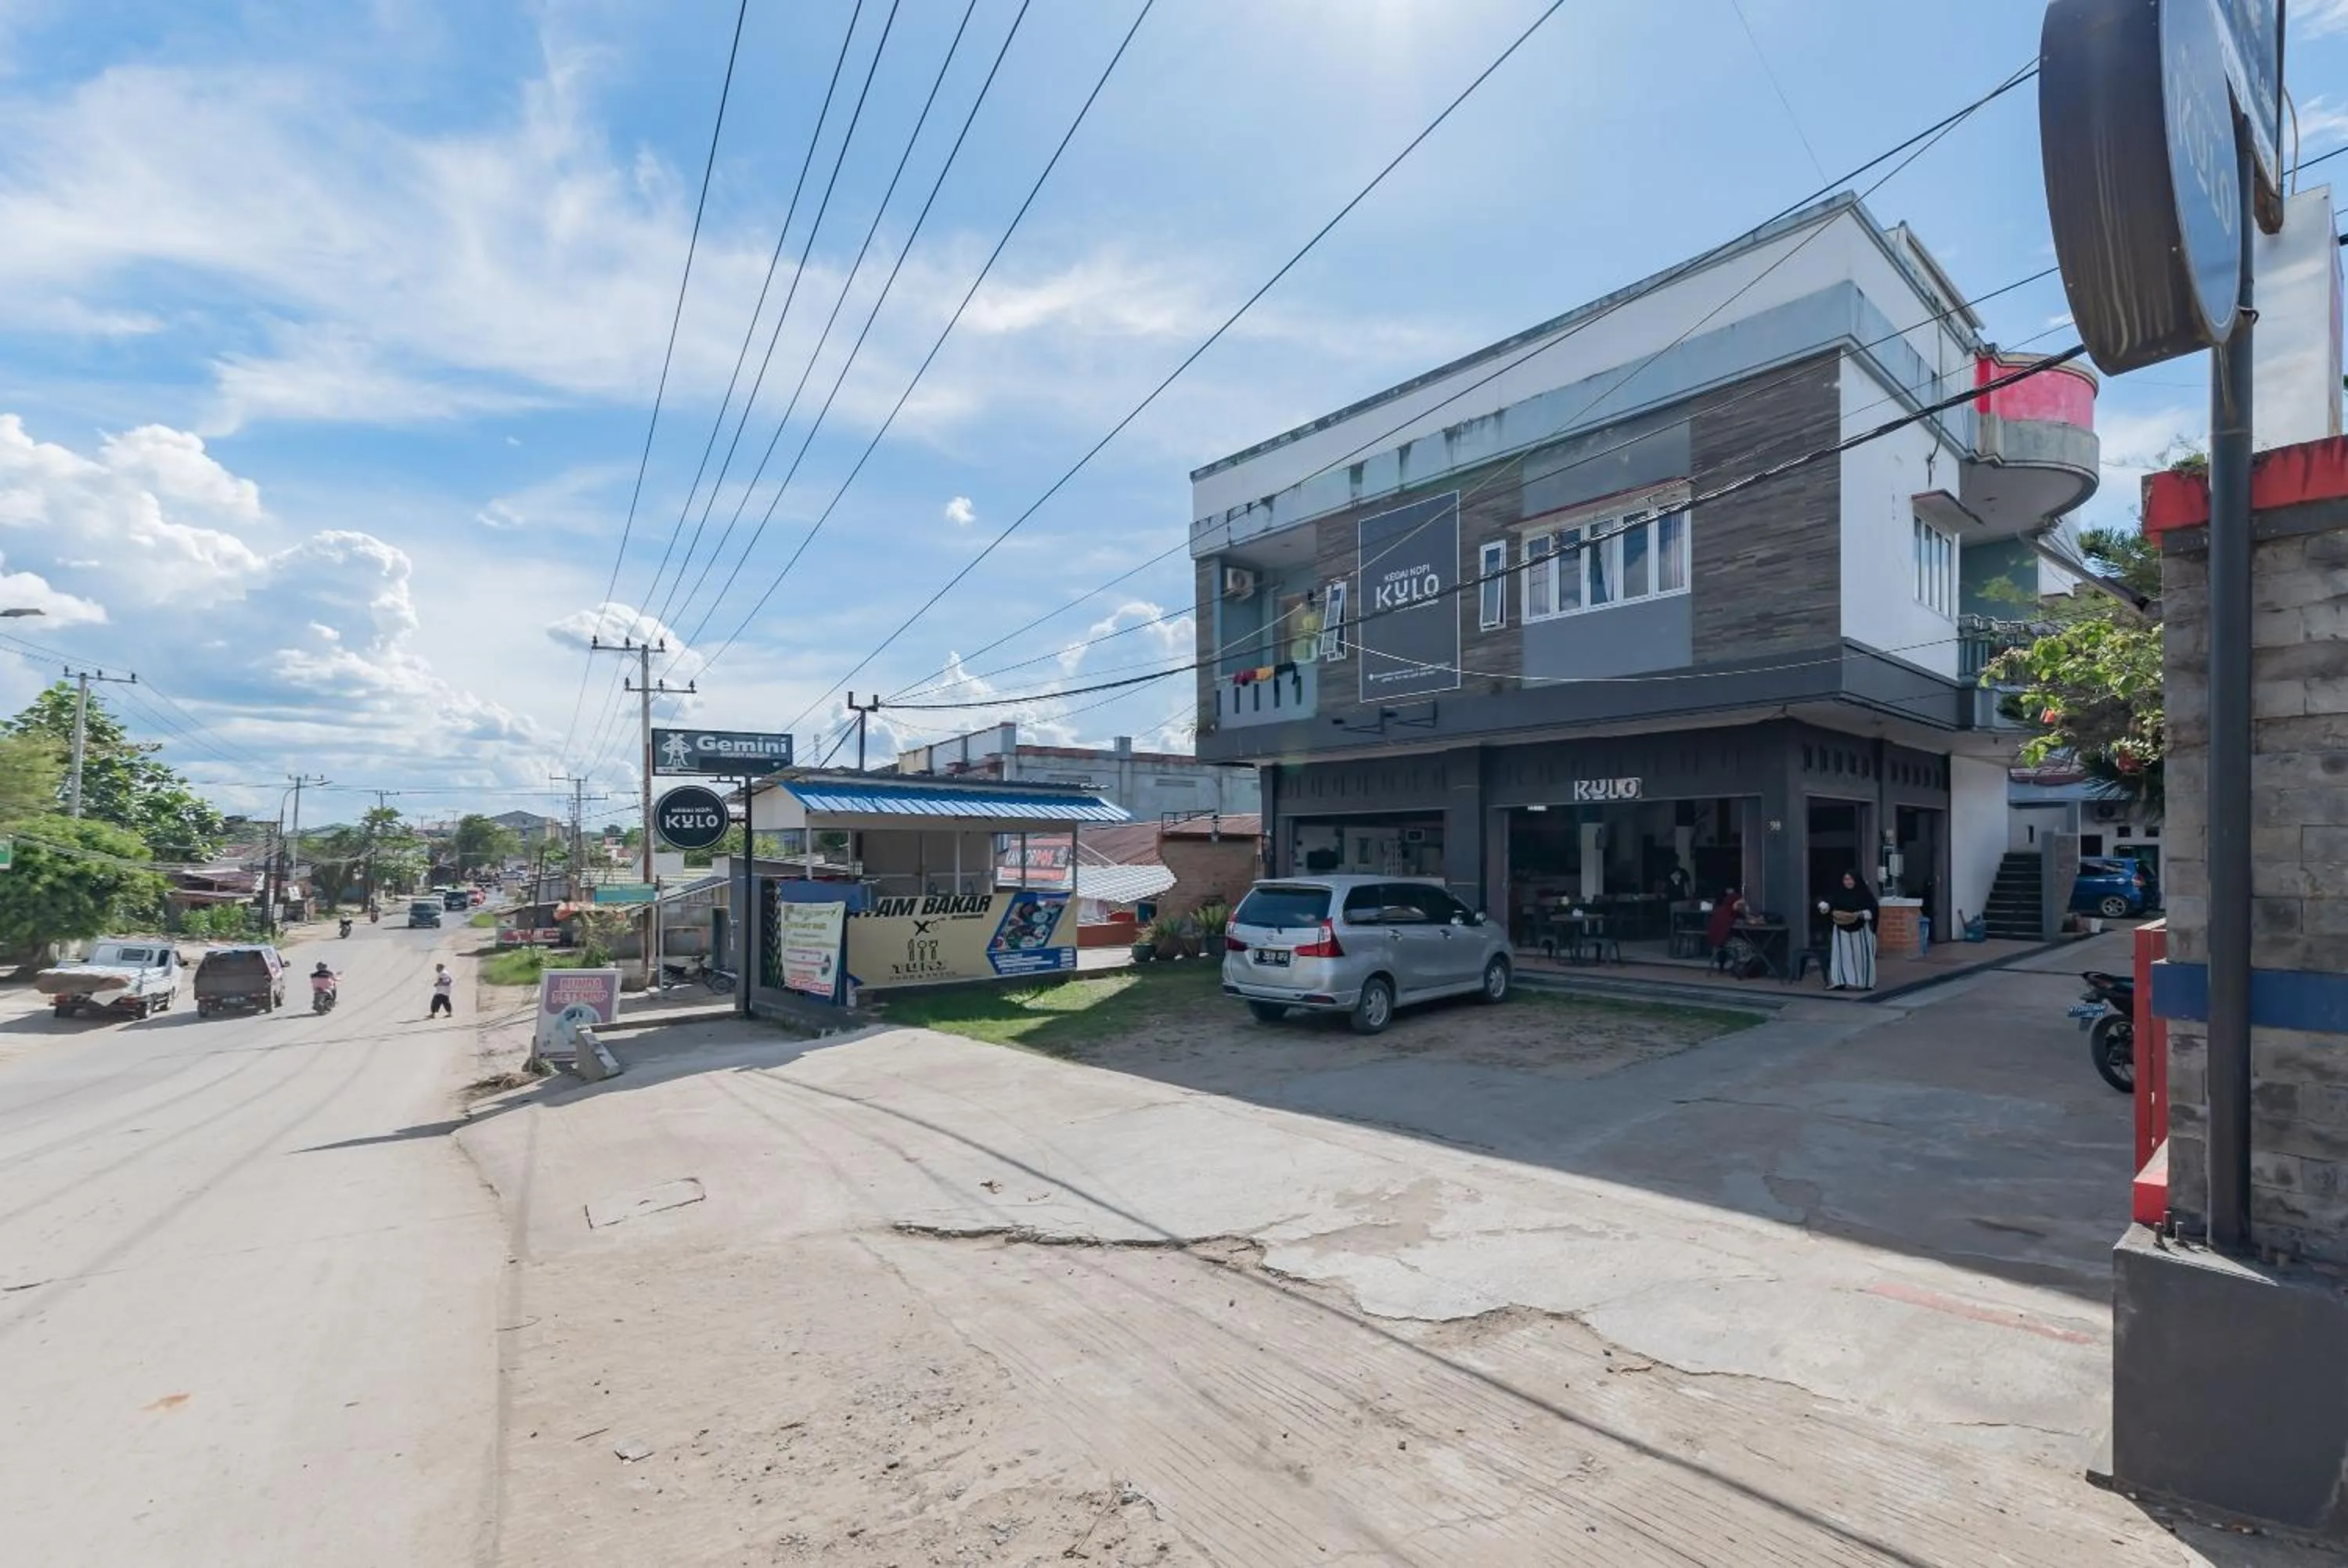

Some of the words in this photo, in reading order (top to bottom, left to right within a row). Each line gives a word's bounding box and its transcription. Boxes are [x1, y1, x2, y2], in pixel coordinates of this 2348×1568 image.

[1376, 574, 1439, 609] KULO
[696, 735, 787, 753] Gemini
[1574, 778, 1642, 800] KULO
[665, 815, 718, 829] KULO
[920, 895, 992, 915] BAKAR
